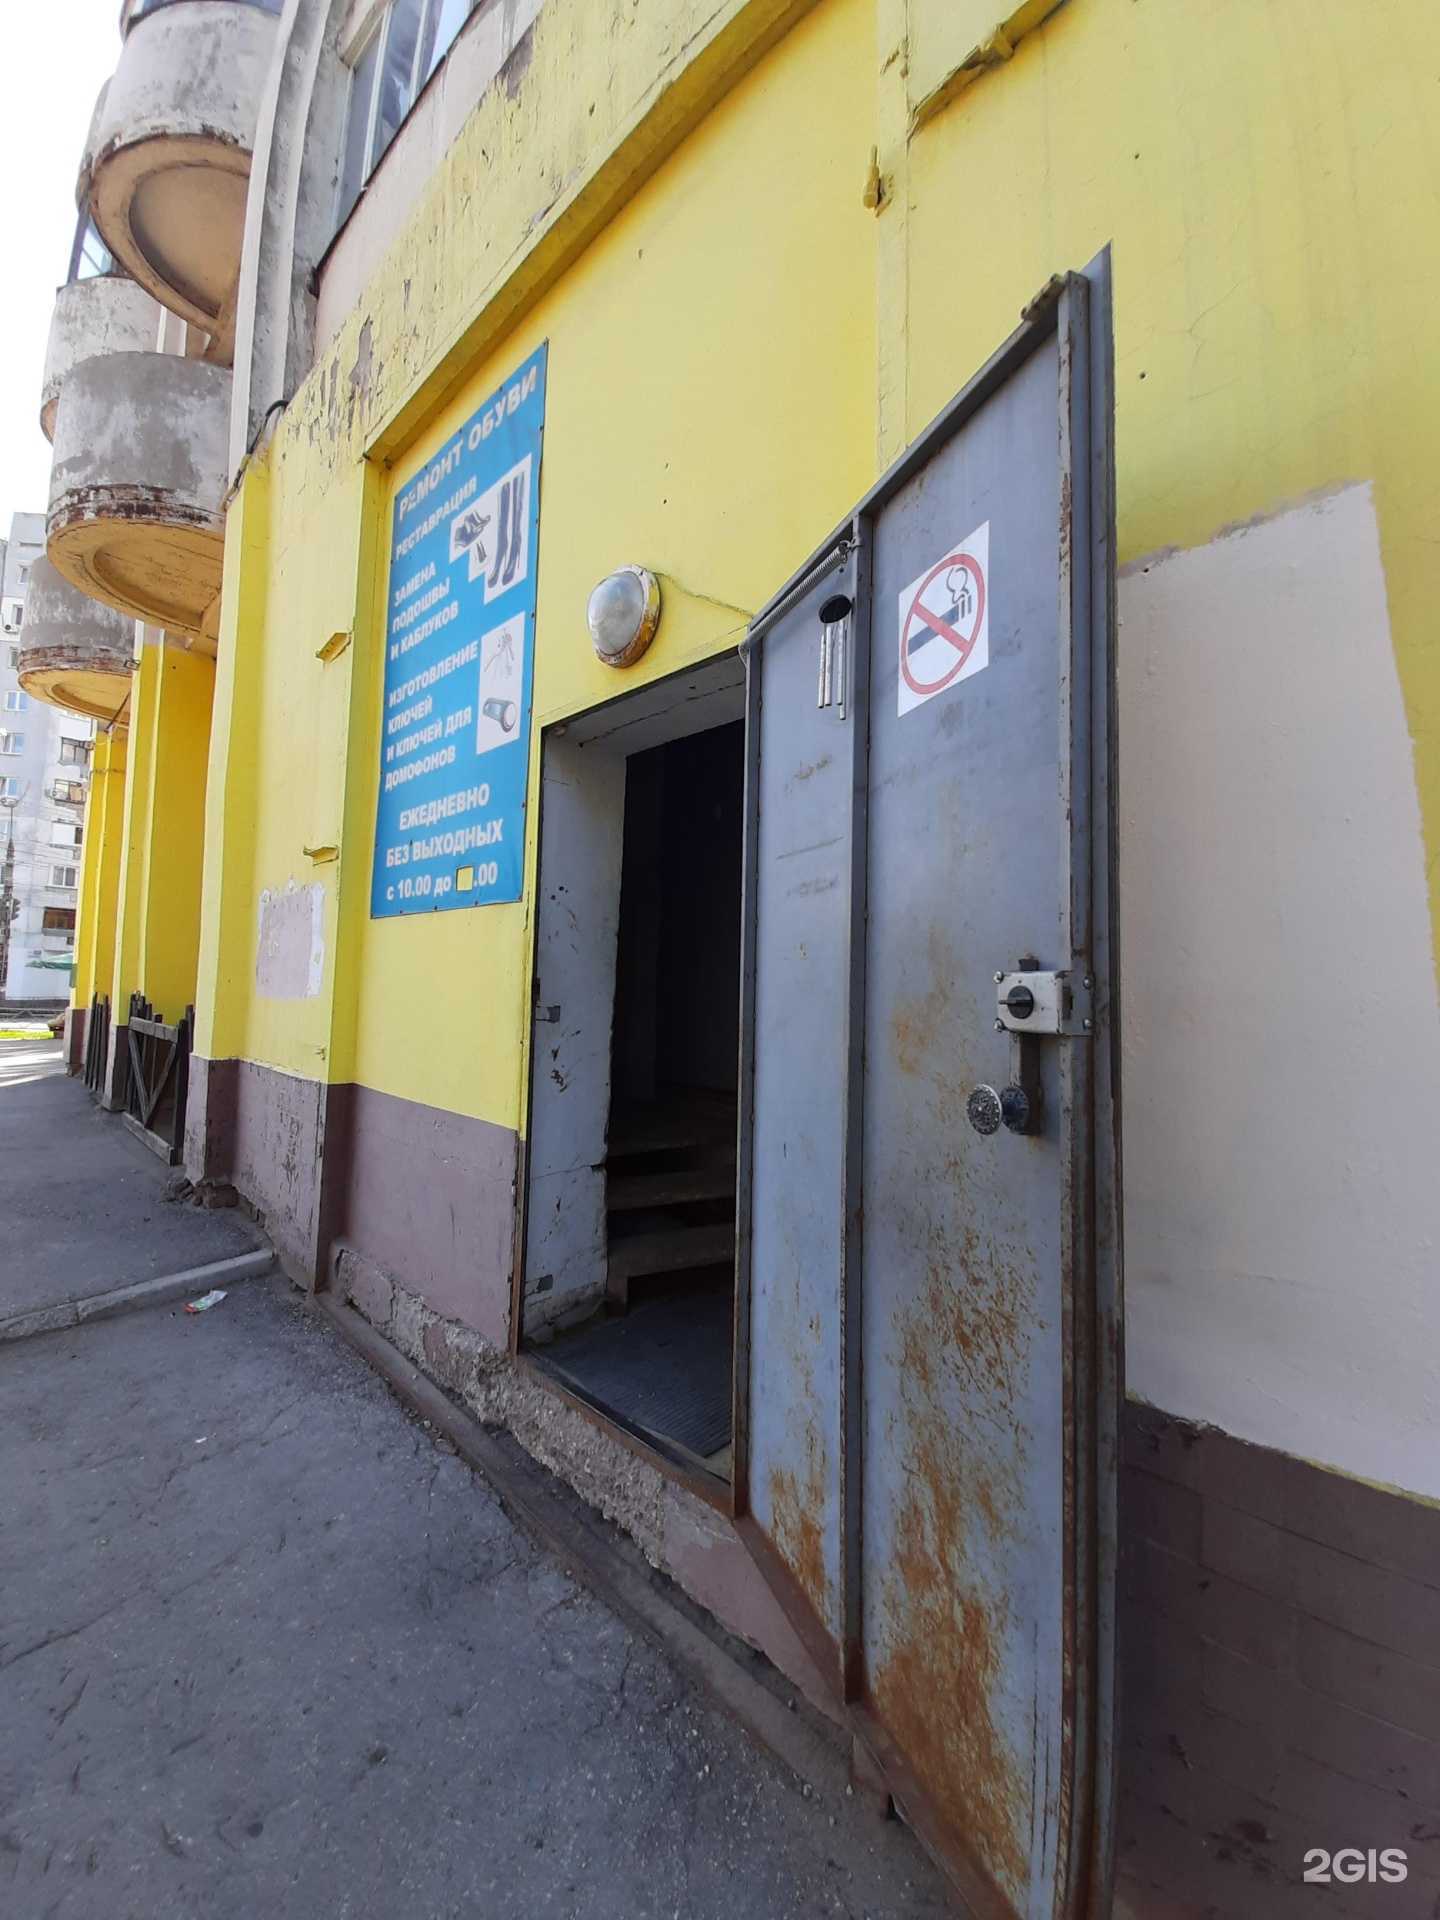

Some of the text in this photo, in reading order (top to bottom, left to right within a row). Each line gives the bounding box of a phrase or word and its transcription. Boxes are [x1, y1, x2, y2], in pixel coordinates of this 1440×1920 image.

[398, 366, 537, 522] РЕМОНТ ОБУВИ
[395, 475, 477, 559] РЕСТАВРАЦИЯ
[391, 577, 450, 633] ПОДОШВЫ
[393, 561, 436, 607] ЗАМЕНА
[390, 601, 459, 661] И КАБЛУКОВ
[388, 640, 479, 708] ИЗГОТОВЛЕНИЕ
[386, 705, 472, 763] И КЛЮЧЕЙ ДЛЯ
[387, 695, 433, 735] КЛЮЧЕЙ
[385, 745, 456, 792] ДОМОФОНОВ
[399, 783, 490, 831] ЕЖЕДНЕВНО
[386, 818, 504, 868] БЕЗ ВЫХОДНЫХ
[397, 874, 432, 899] 10.00
[433, 876, 451, 897] до
